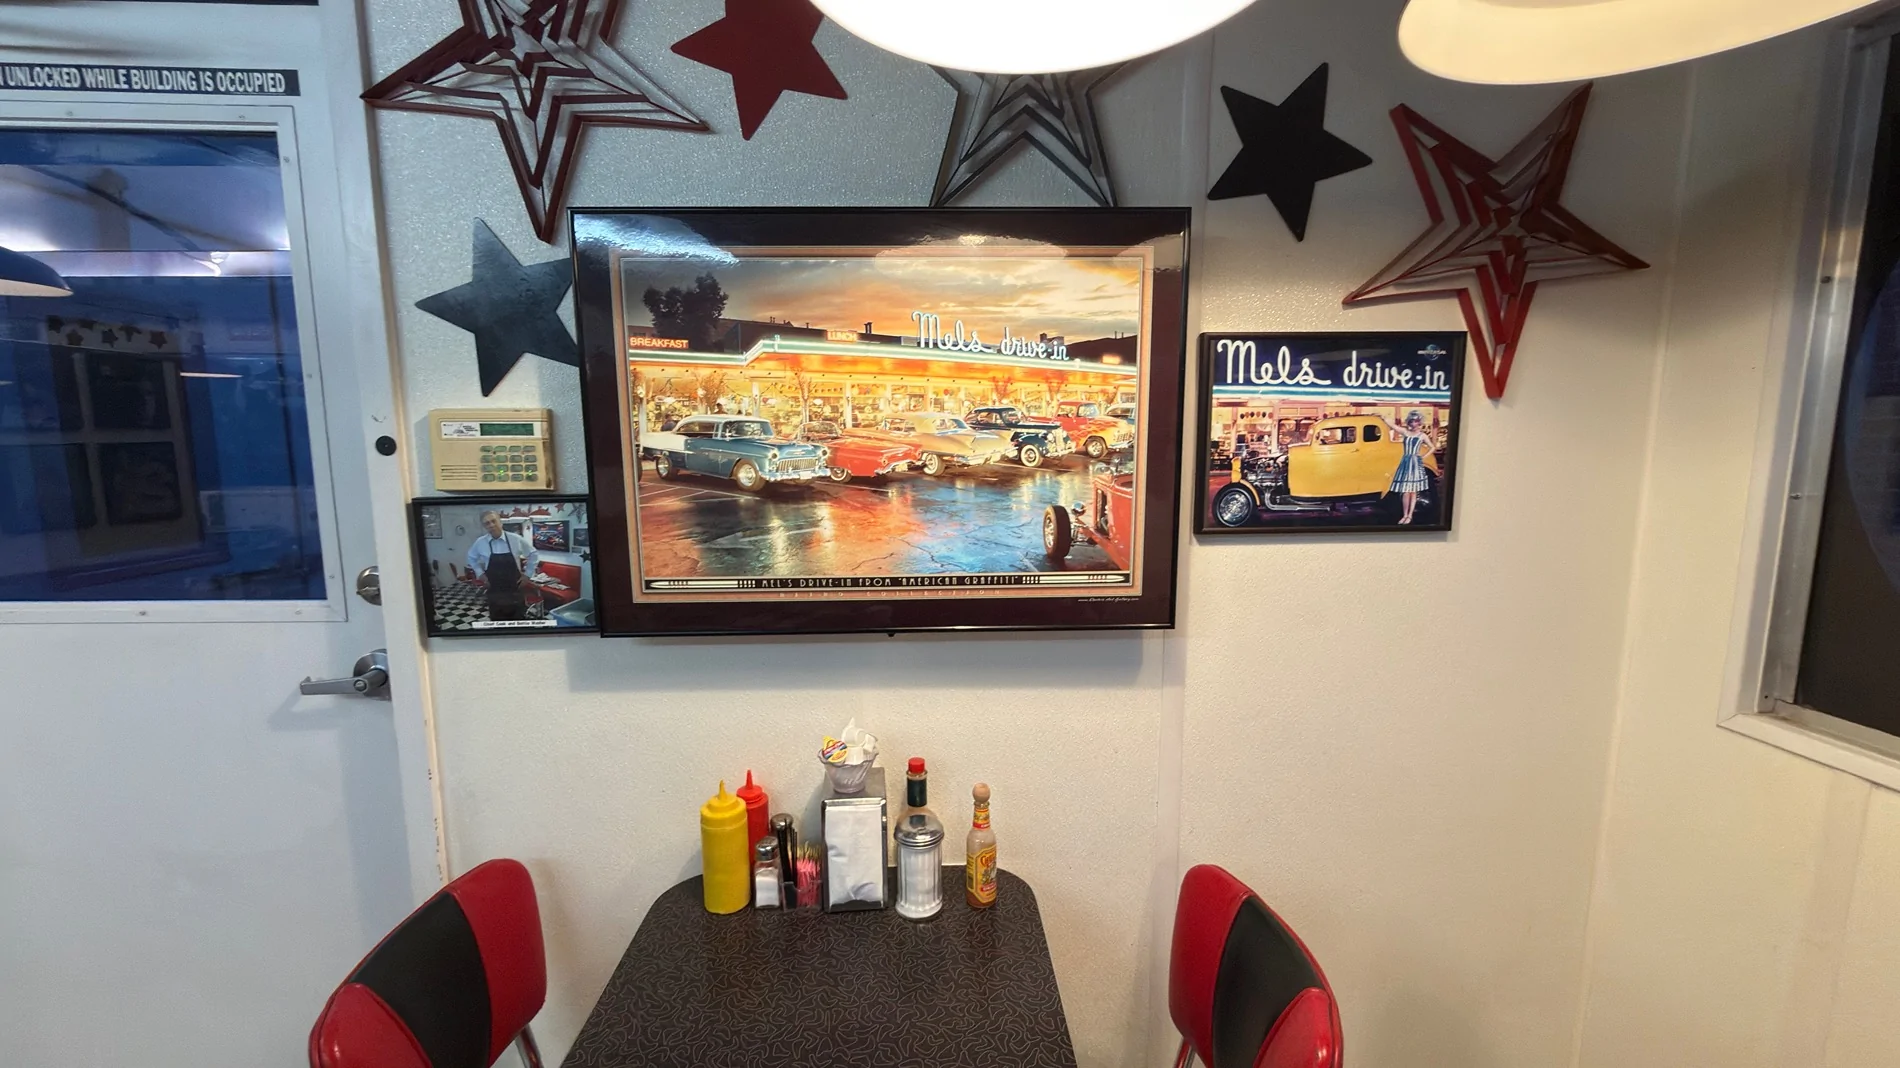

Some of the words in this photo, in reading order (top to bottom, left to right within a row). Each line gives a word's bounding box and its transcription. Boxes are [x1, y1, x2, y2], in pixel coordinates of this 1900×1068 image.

[4, 66, 81, 88] UNLOCKED
[81, 68, 129, 89] WHILE
[130, 69, 198, 91] BUILDING
[199, 71, 214, 92] IS
[216, 72, 286, 93] OCCUPIED
[629, 337, 688, 349] BREAKFAST
[827, 331, 858, 342] LUNCH
[912, 311, 997, 353] Mels
[1001, 327, 1069, 361] drive-in
[1217, 339, 1331, 385] Mels
[1343, 350, 1450, 390] drive-in
[762, 579, 793, 588] MEL'S
[800, 578, 852, 587] DRIVE-IN
[859, 578, 892, 586] FROM
